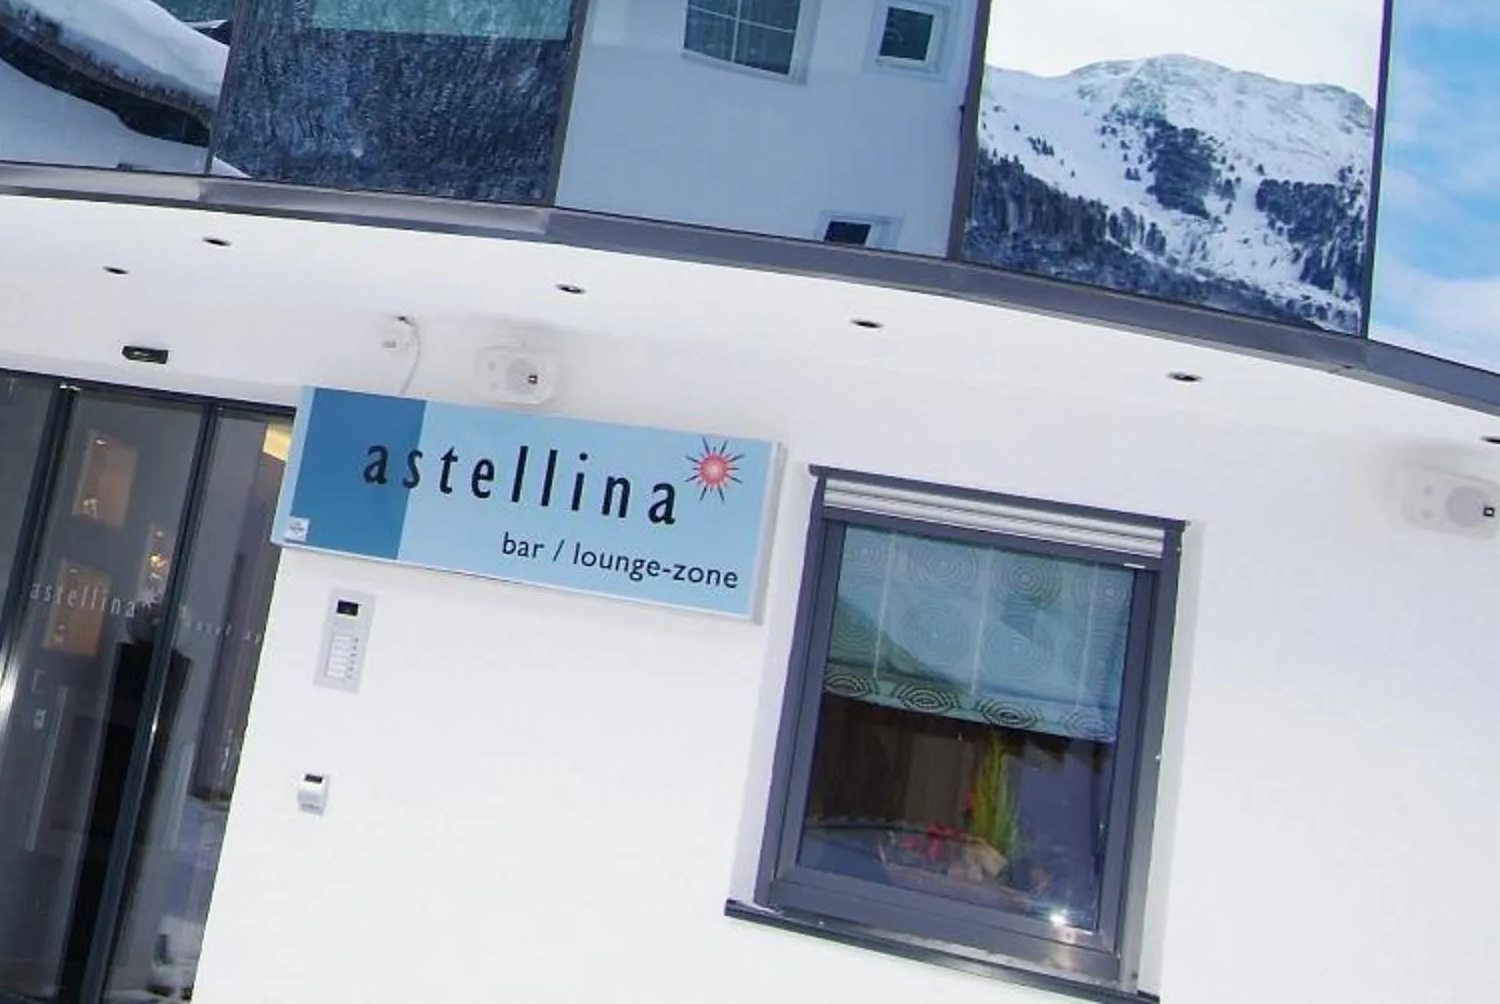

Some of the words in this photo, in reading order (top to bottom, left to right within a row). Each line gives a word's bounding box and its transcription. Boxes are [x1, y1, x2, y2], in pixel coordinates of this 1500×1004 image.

[363, 443, 677, 525] astellina
[501, 531, 545, 559] bar
[552, 539, 565, 563] /
[572, 542, 739, 589] lounge-zone
